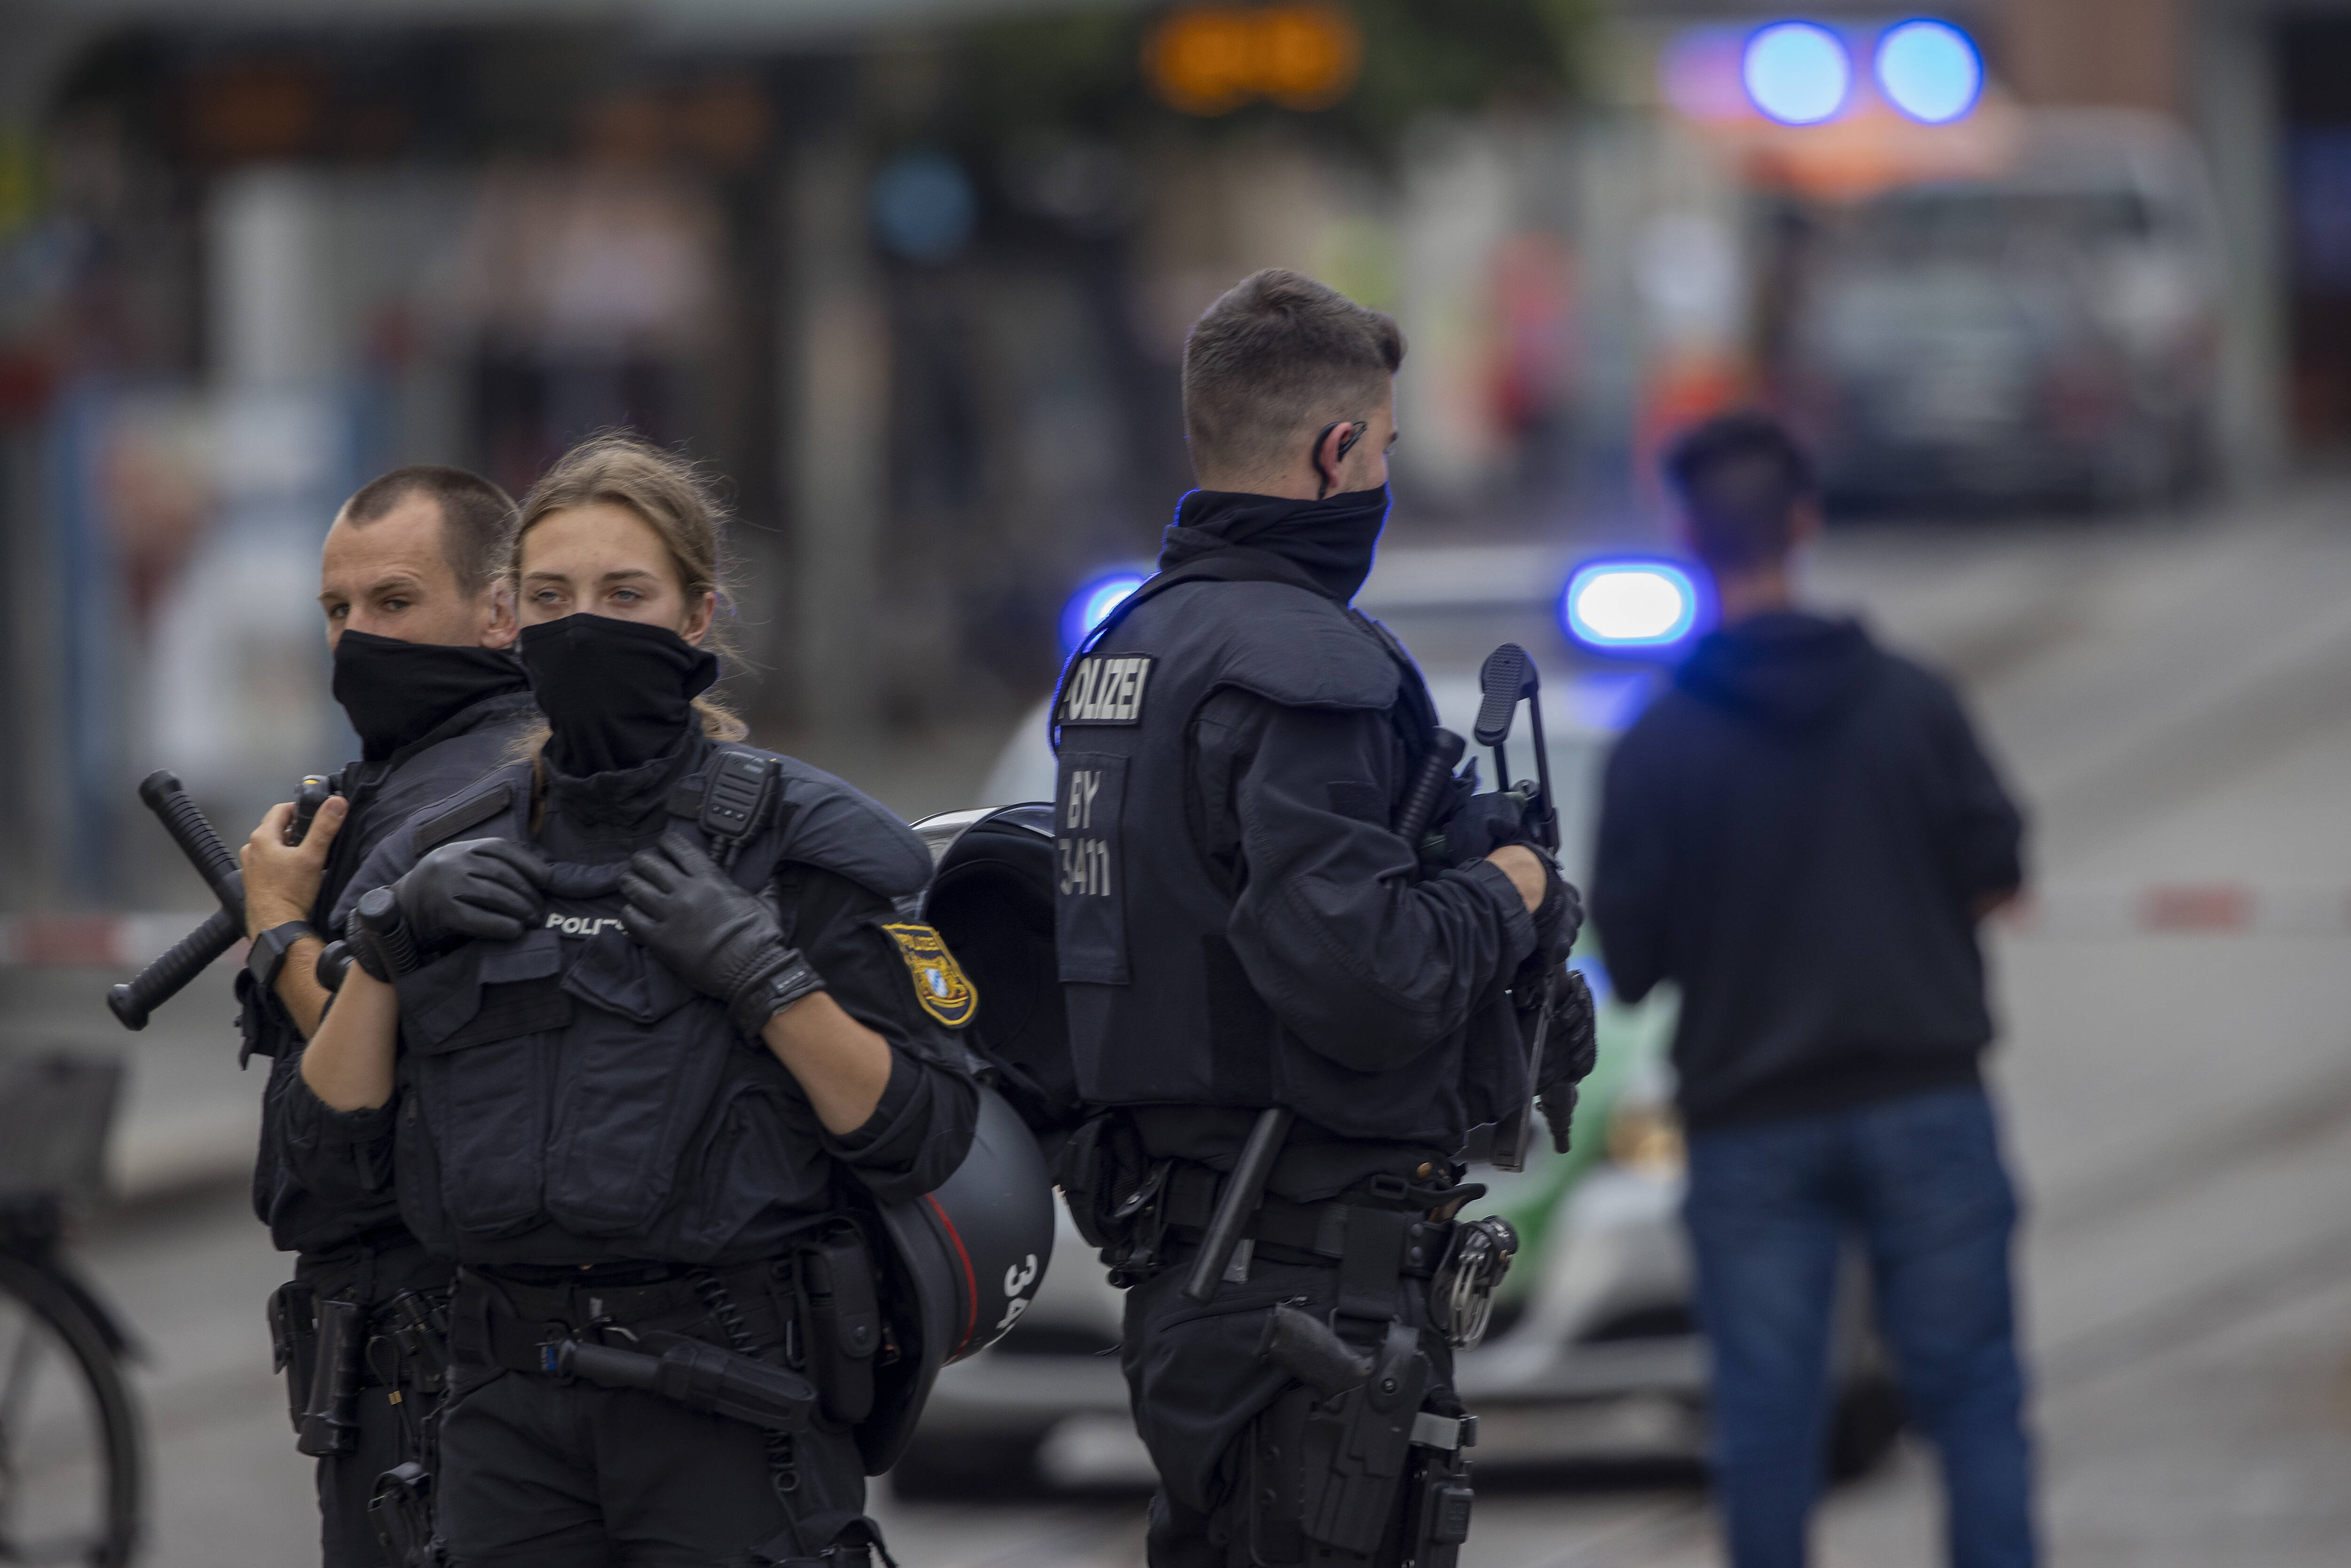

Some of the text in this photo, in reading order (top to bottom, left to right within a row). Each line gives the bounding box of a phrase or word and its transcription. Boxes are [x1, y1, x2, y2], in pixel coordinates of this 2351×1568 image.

[1066, 770, 1102, 829] BY
[1058, 837, 1111, 897] 3411
[544, 912, 631, 936] POLI
[994, 1253, 1038, 1332] 34
